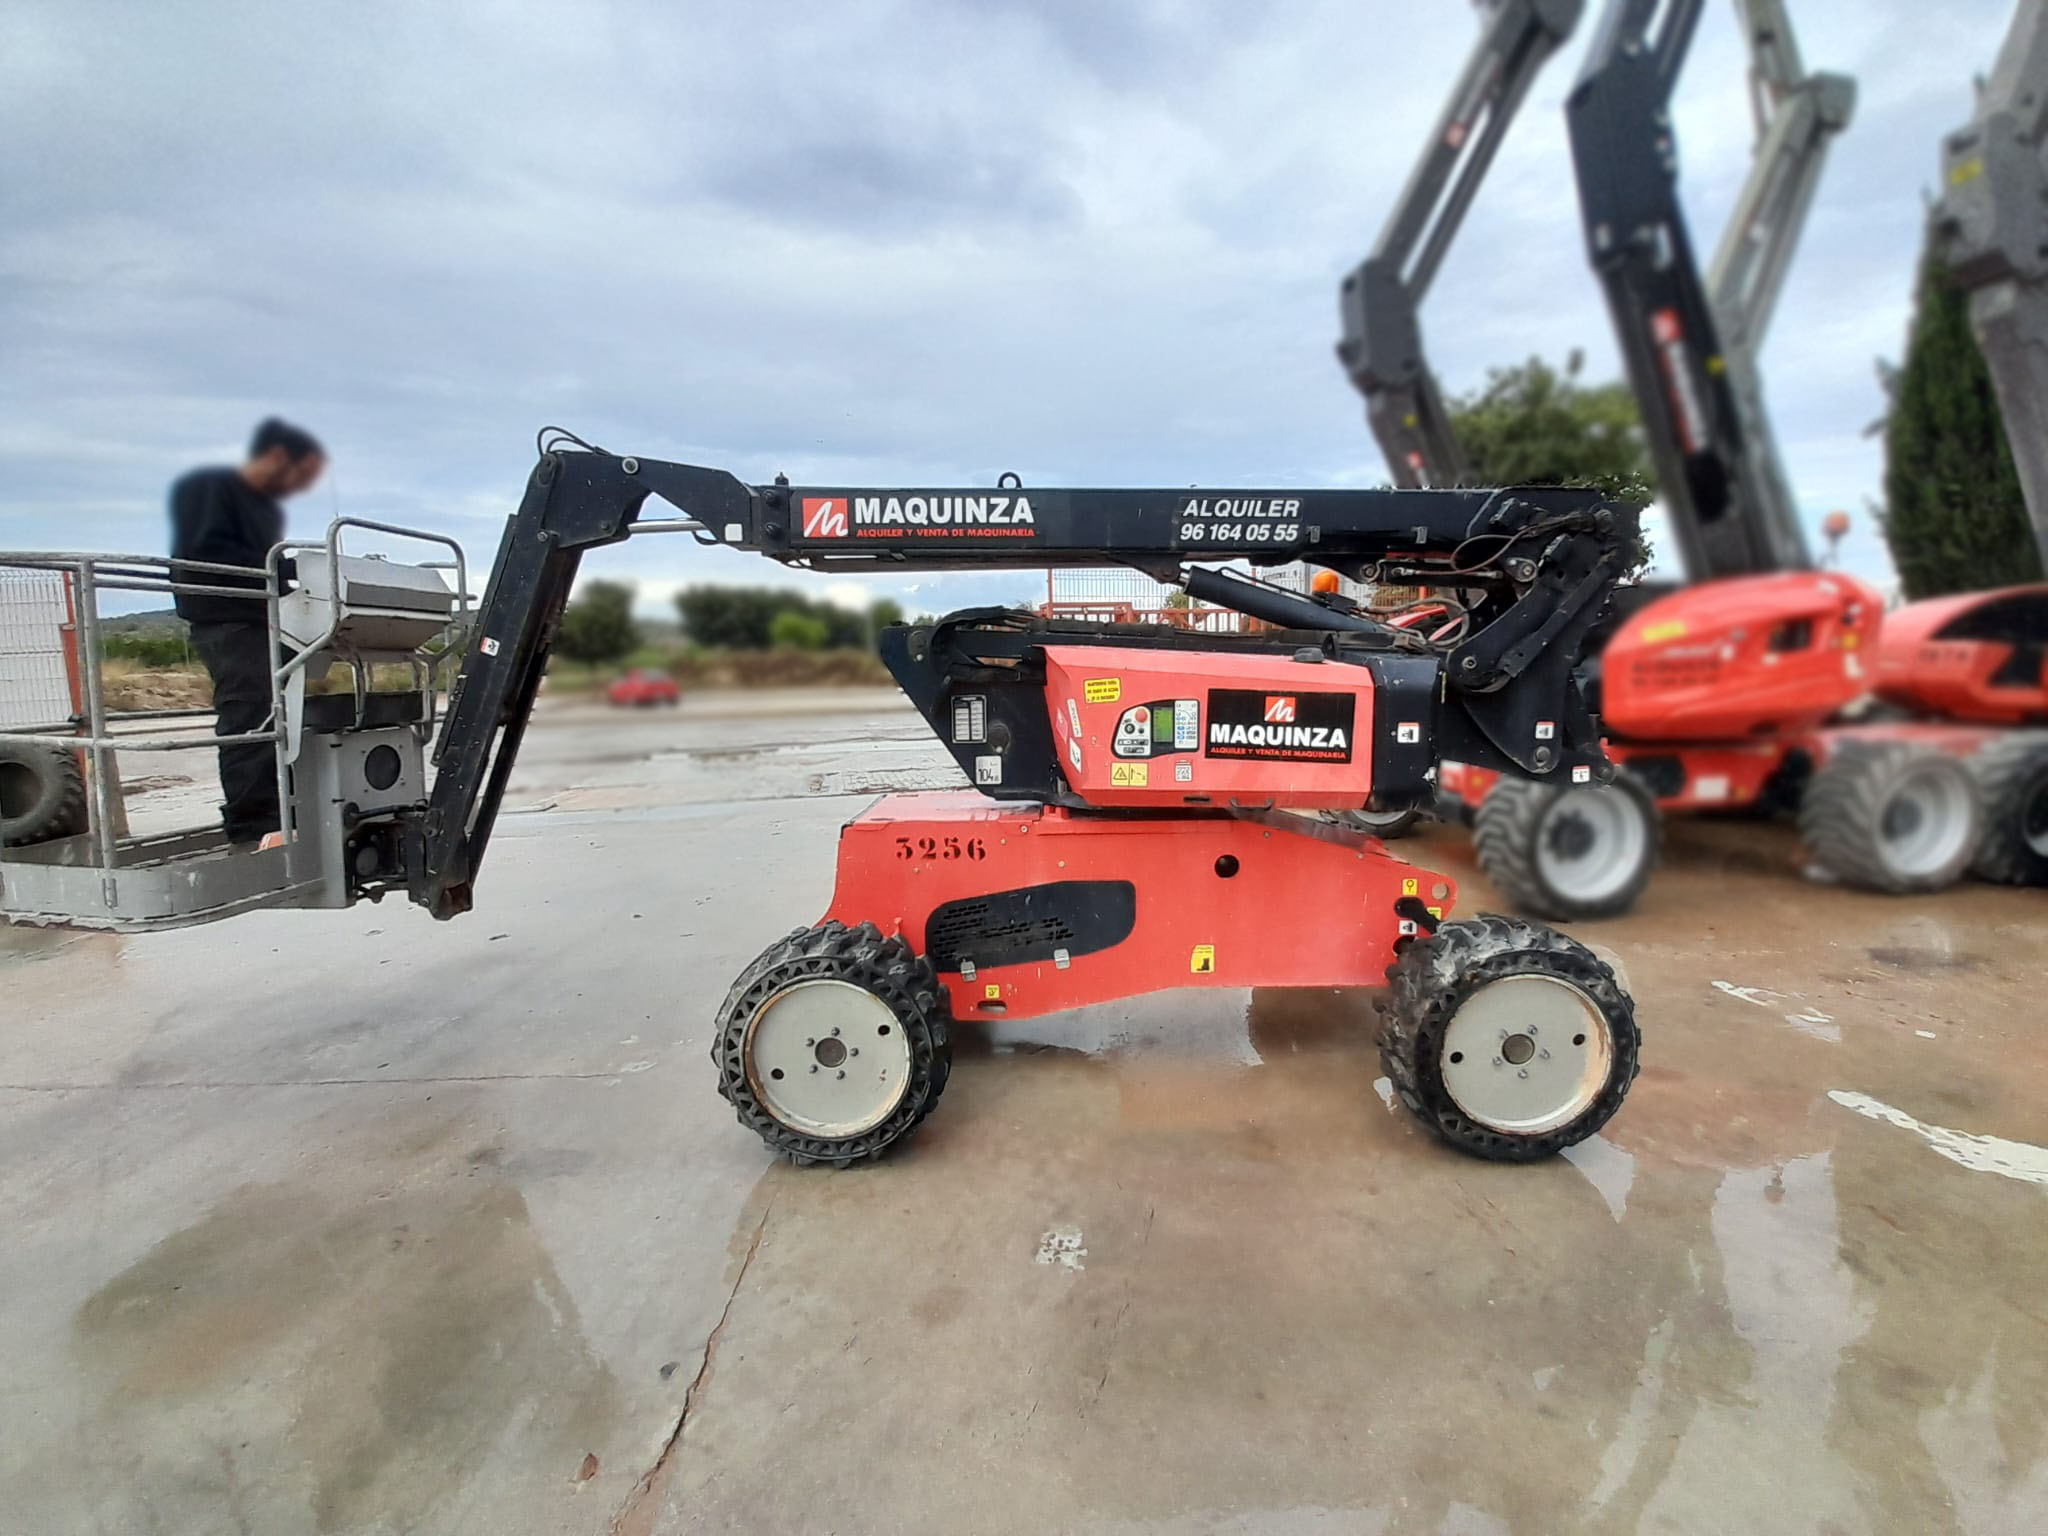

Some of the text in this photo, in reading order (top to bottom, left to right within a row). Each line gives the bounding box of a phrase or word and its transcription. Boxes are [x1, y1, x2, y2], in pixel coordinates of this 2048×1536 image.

[855, 498, 1034, 526] MAQUINZA
[1183, 499, 1300, 517] ALQUILER
[857, 529, 1034, 537] ALQUILER Y VENTA DE MAQUINARIA
[1180, 523, 1299, 541] 96 164 05 55
[1210, 724, 1346, 748] MAQUINZA
[1294, 750, 1346, 759] MAQUINARIA
[896, 837, 986, 861] 3256
